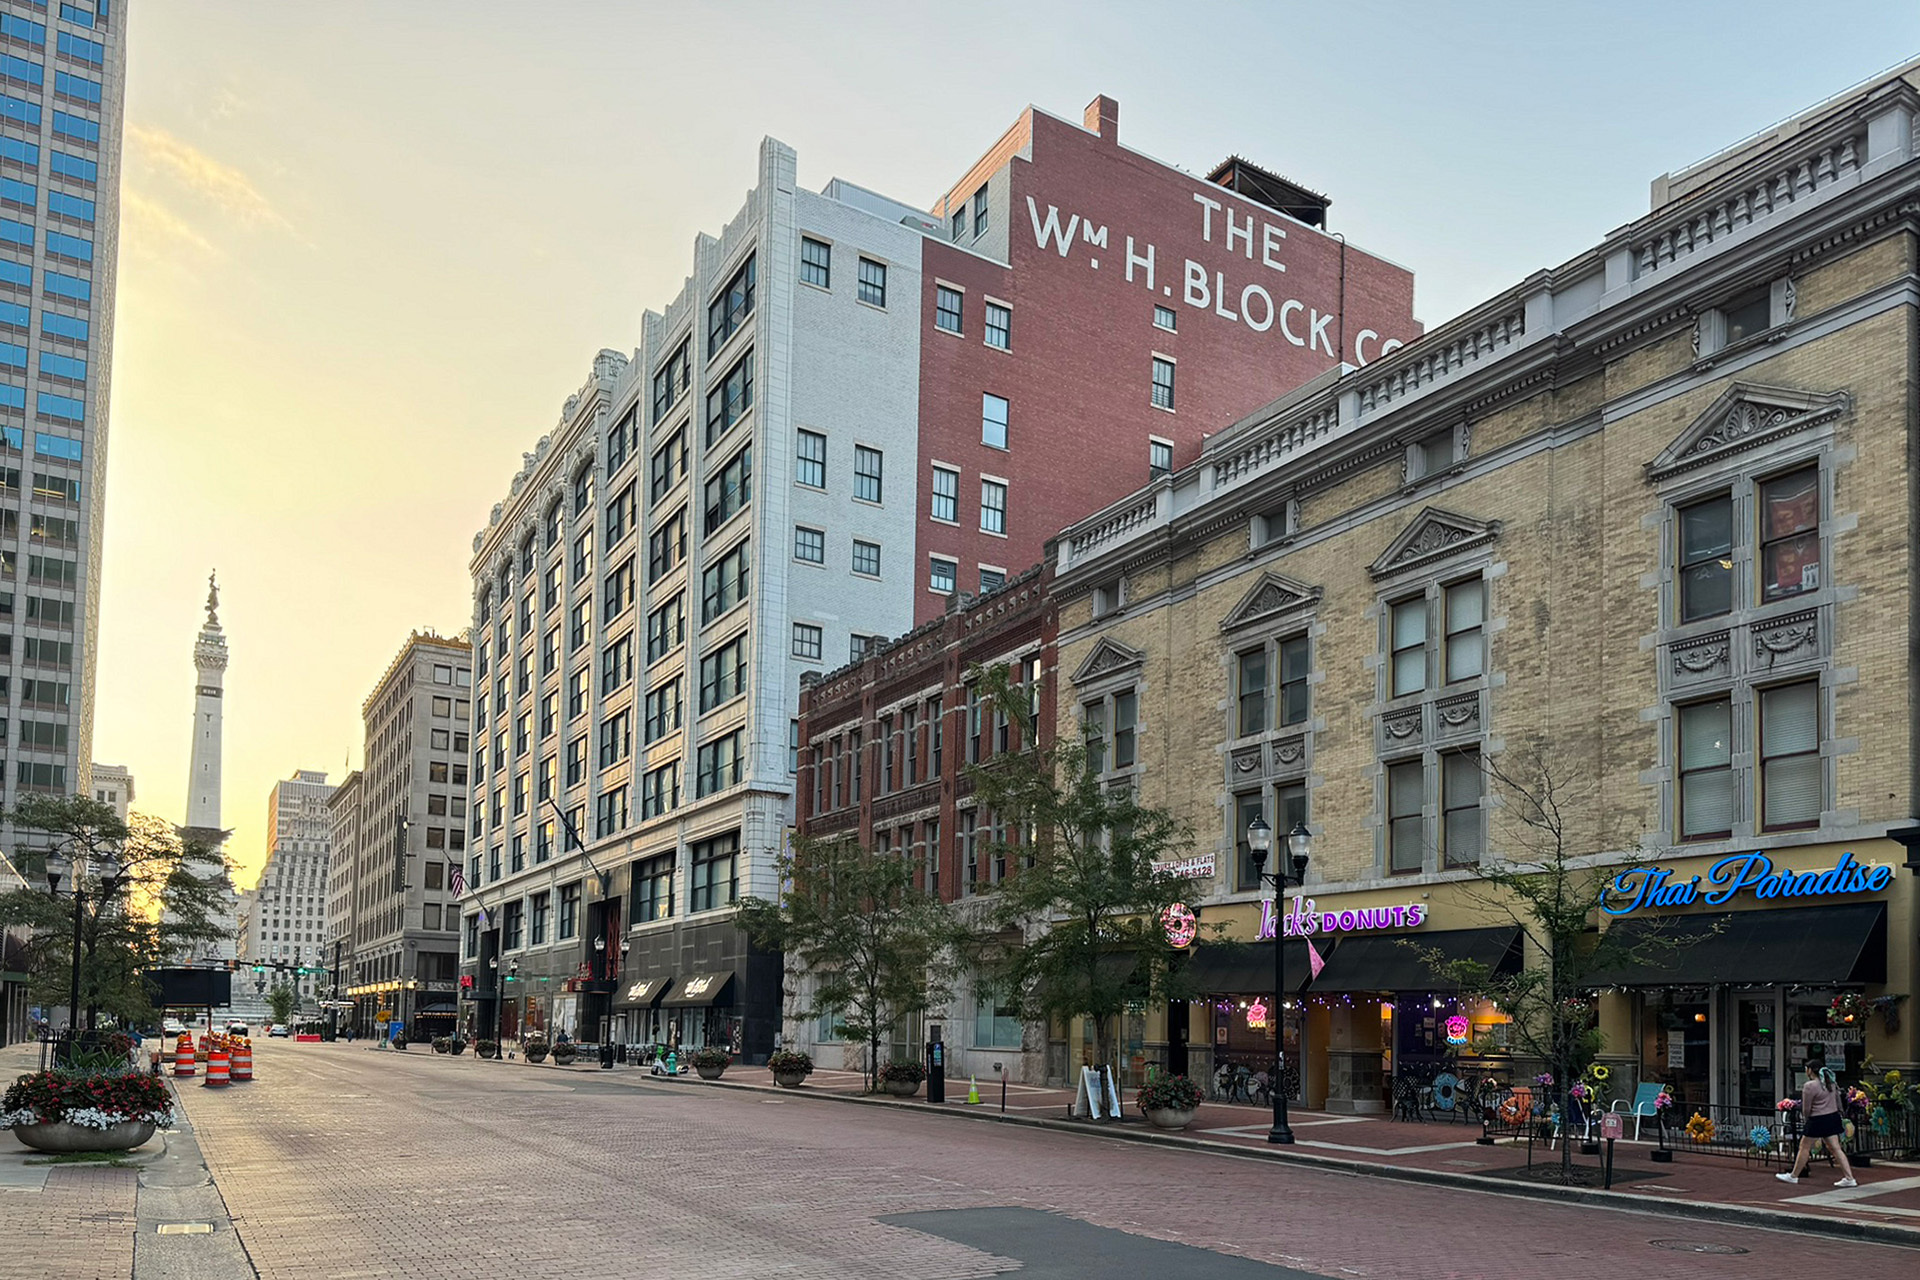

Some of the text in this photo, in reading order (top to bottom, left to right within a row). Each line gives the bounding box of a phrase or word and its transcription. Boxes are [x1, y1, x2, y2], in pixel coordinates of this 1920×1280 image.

[1193, 192, 1287, 273] THE
[1184, 258, 1335, 358] BLOCK
[1600, 850, 1891, 915] Thai Paradise
[1255, 895, 1424, 940] Jack's DONUTS
[1249, 1020, 1266, 1028] OPEN
[1807, 1029, 1859, 1041] CARRY OUT
